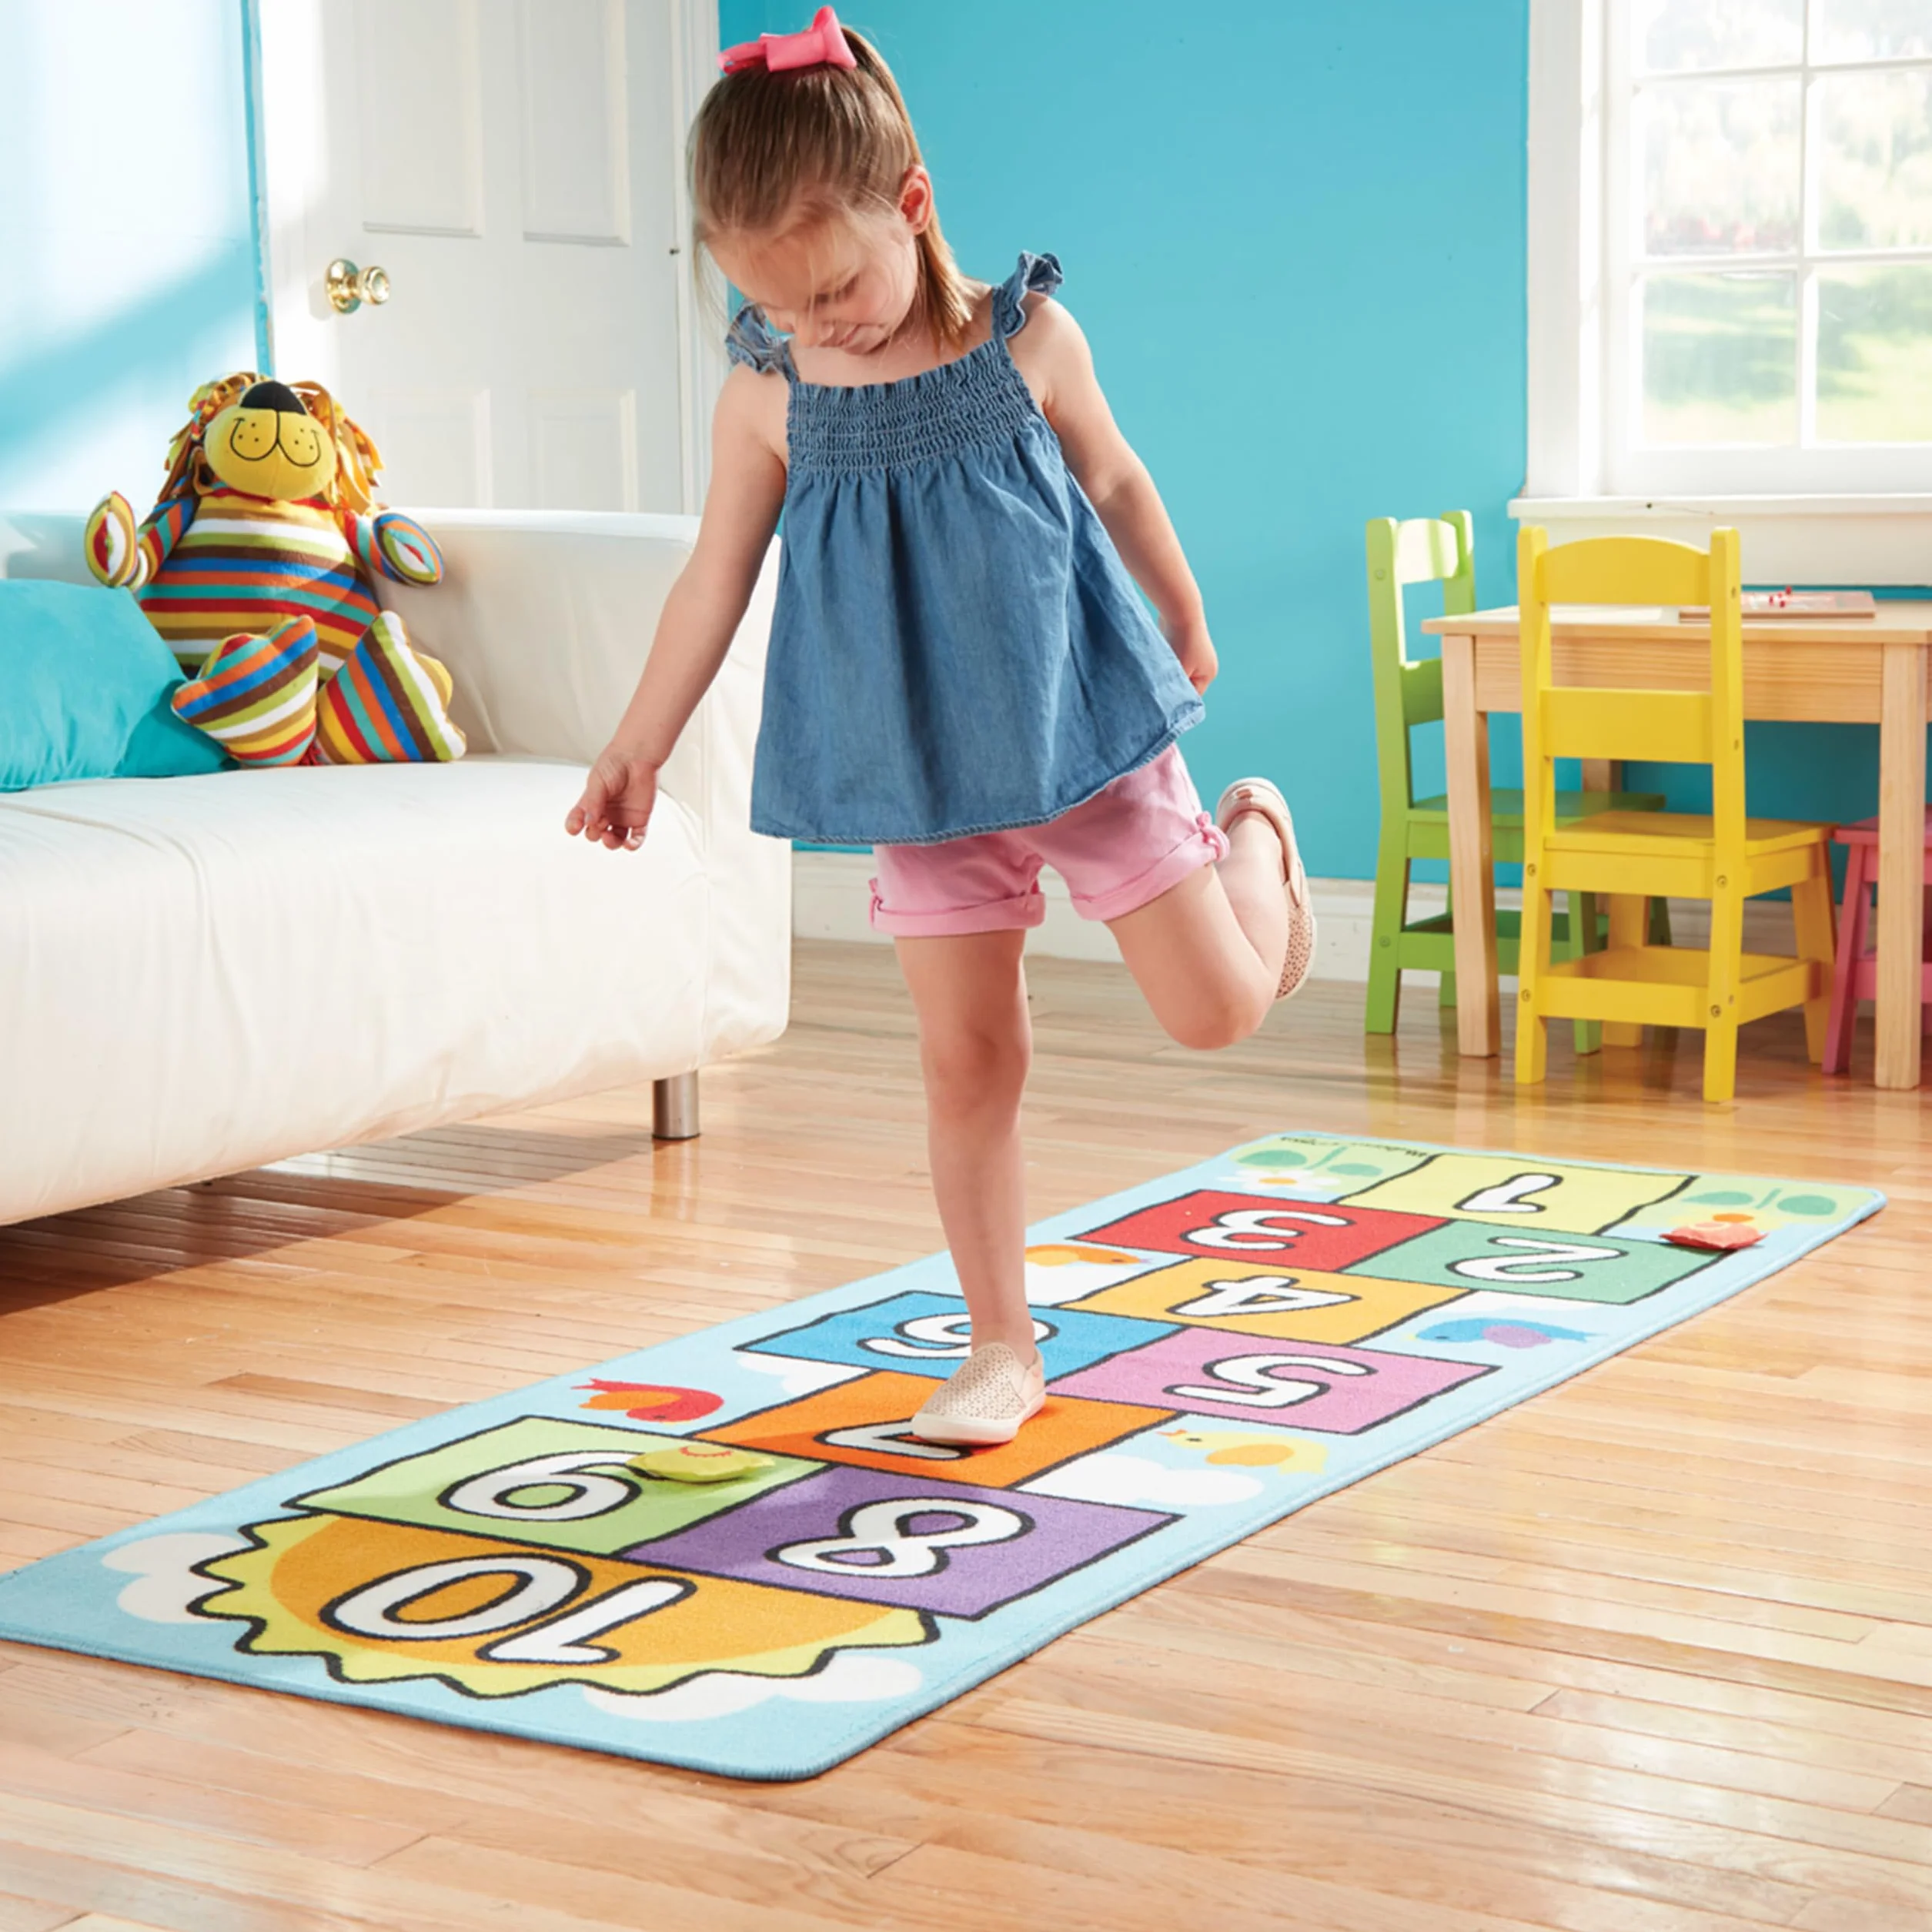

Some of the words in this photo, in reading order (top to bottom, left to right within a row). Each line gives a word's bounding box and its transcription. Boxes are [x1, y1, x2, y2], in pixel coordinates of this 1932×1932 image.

[1456, 1172, 1564, 1216] 1
[1181, 1208, 1353, 1253] 3
[1447, 1235, 1630, 1285] 2
[1168, 1275, 1362, 1318] 4
[1165, 1351, 1379, 1409] 5
[763, 1496, 1036, 1578] 8
[319, 1552, 698, 1664] 10
